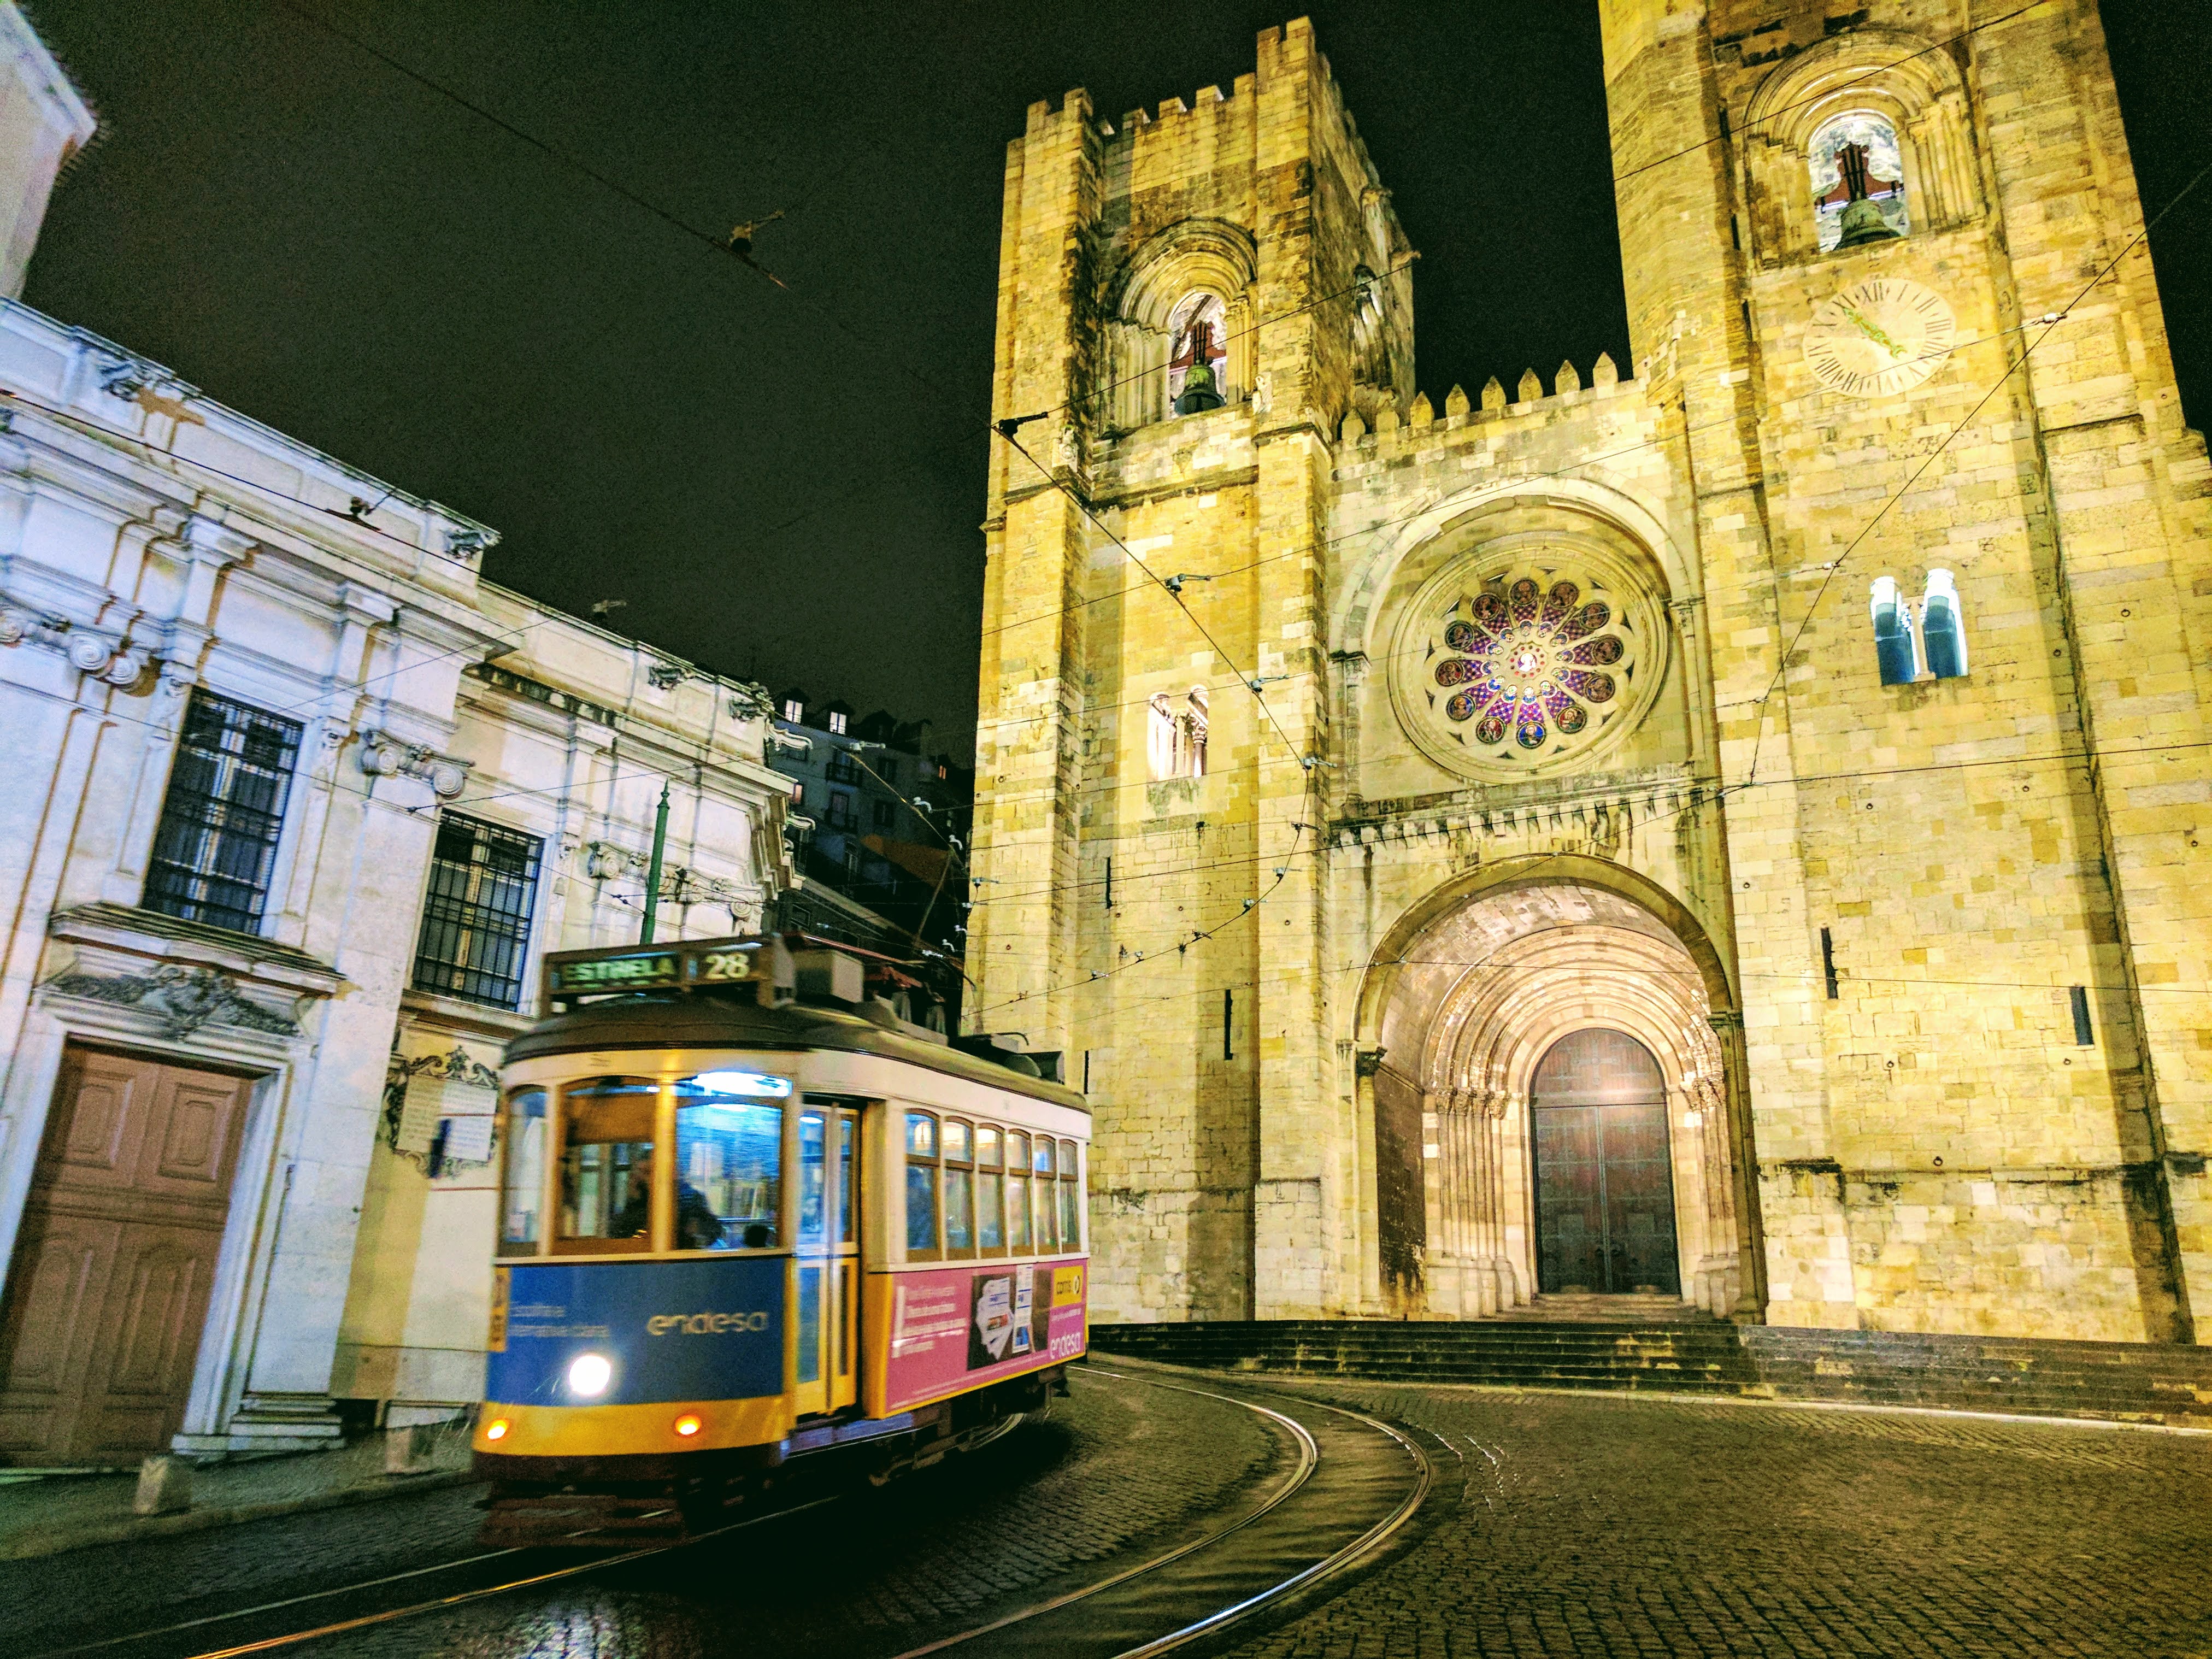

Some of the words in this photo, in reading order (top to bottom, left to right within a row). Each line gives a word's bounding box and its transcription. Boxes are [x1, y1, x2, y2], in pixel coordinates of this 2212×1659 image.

[705, 953, 749, 980] 28
[647, 1311, 767, 1336] endesa
[1050, 1332, 1081, 1360] endesa
